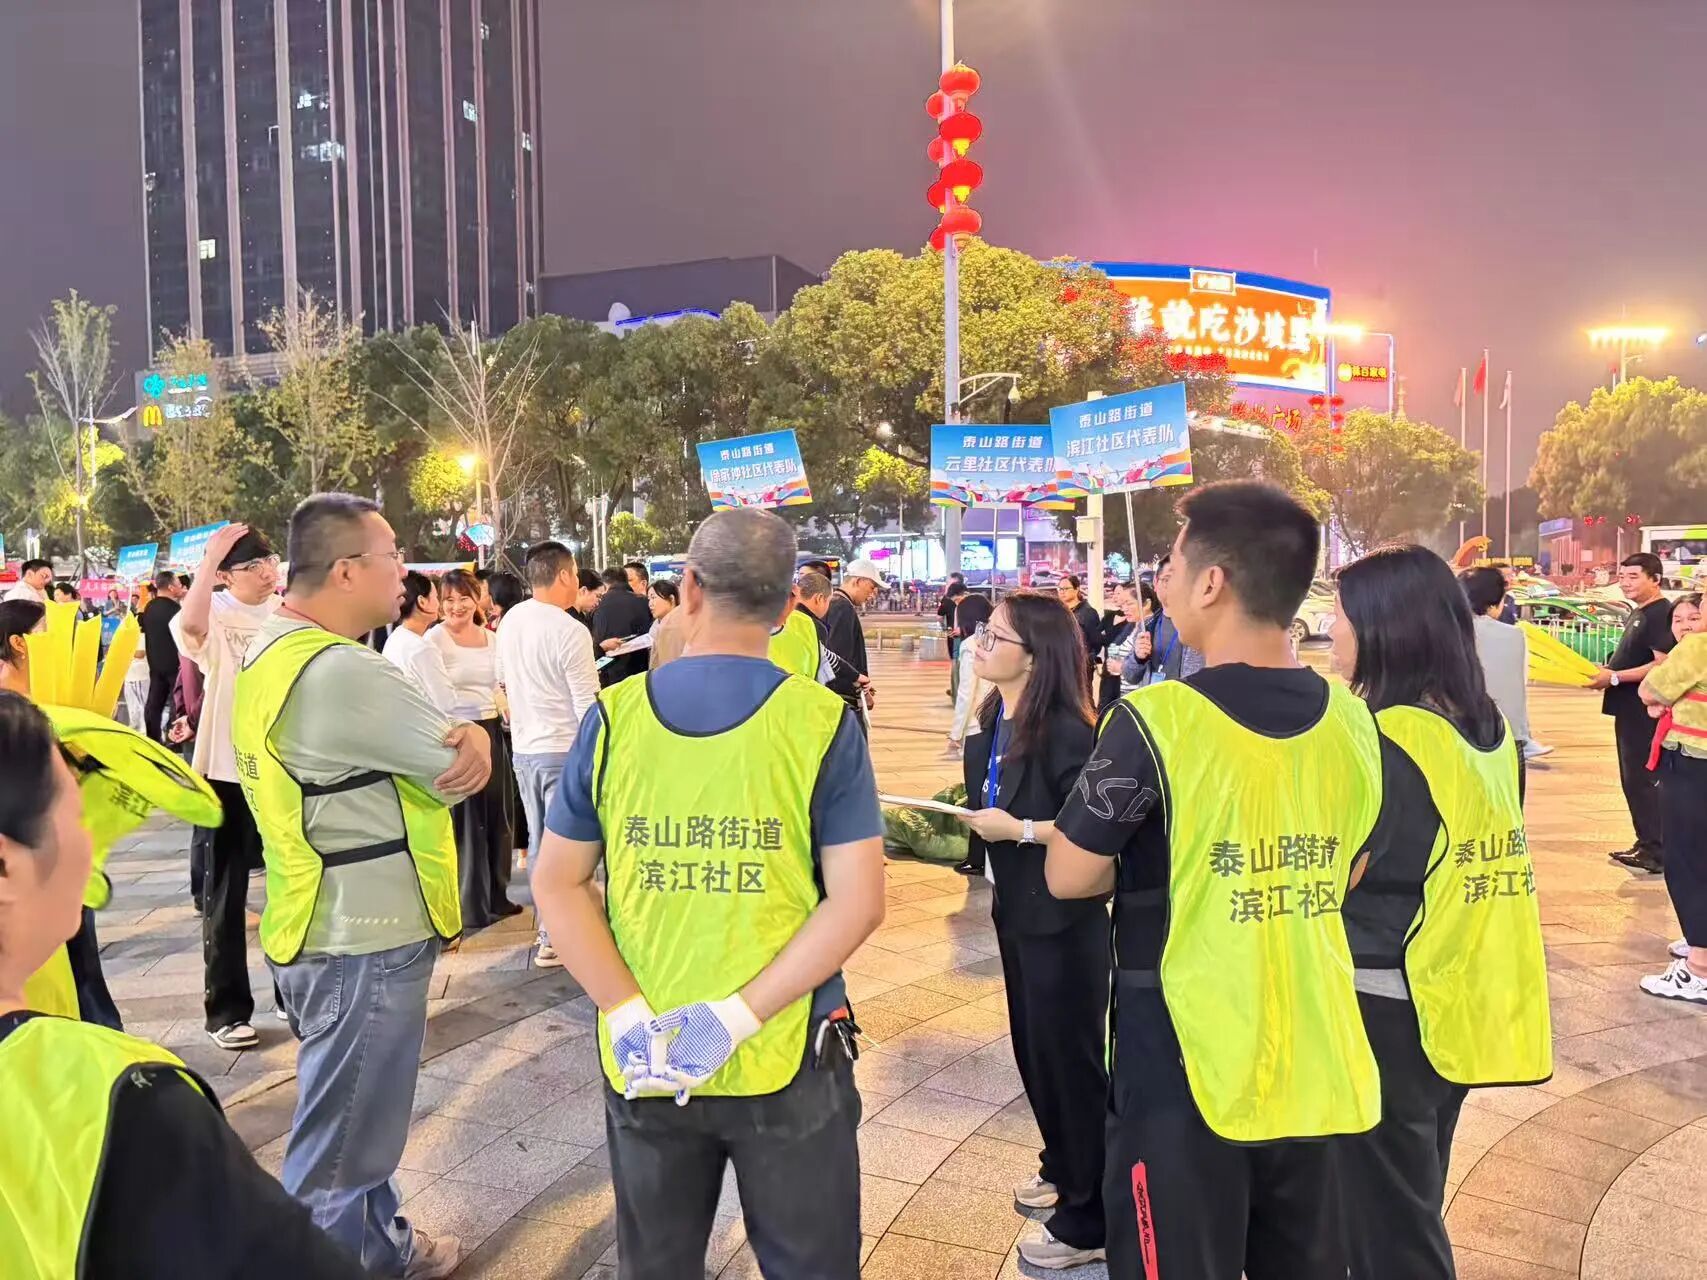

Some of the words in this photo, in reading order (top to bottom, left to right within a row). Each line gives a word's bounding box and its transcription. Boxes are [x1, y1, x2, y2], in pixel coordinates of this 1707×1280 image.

[1079, 402, 1153, 429] 泰山路街道
[720, 442, 774, 461] 泰山路街道
[962, 435, 1044, 449] 泰山路街道
[1066, 424, 1175, 458] 滨江社区代表队
[624, 814, 783, 850] 泰山路街道
[639, 859, 766, 894] 滨江社区
